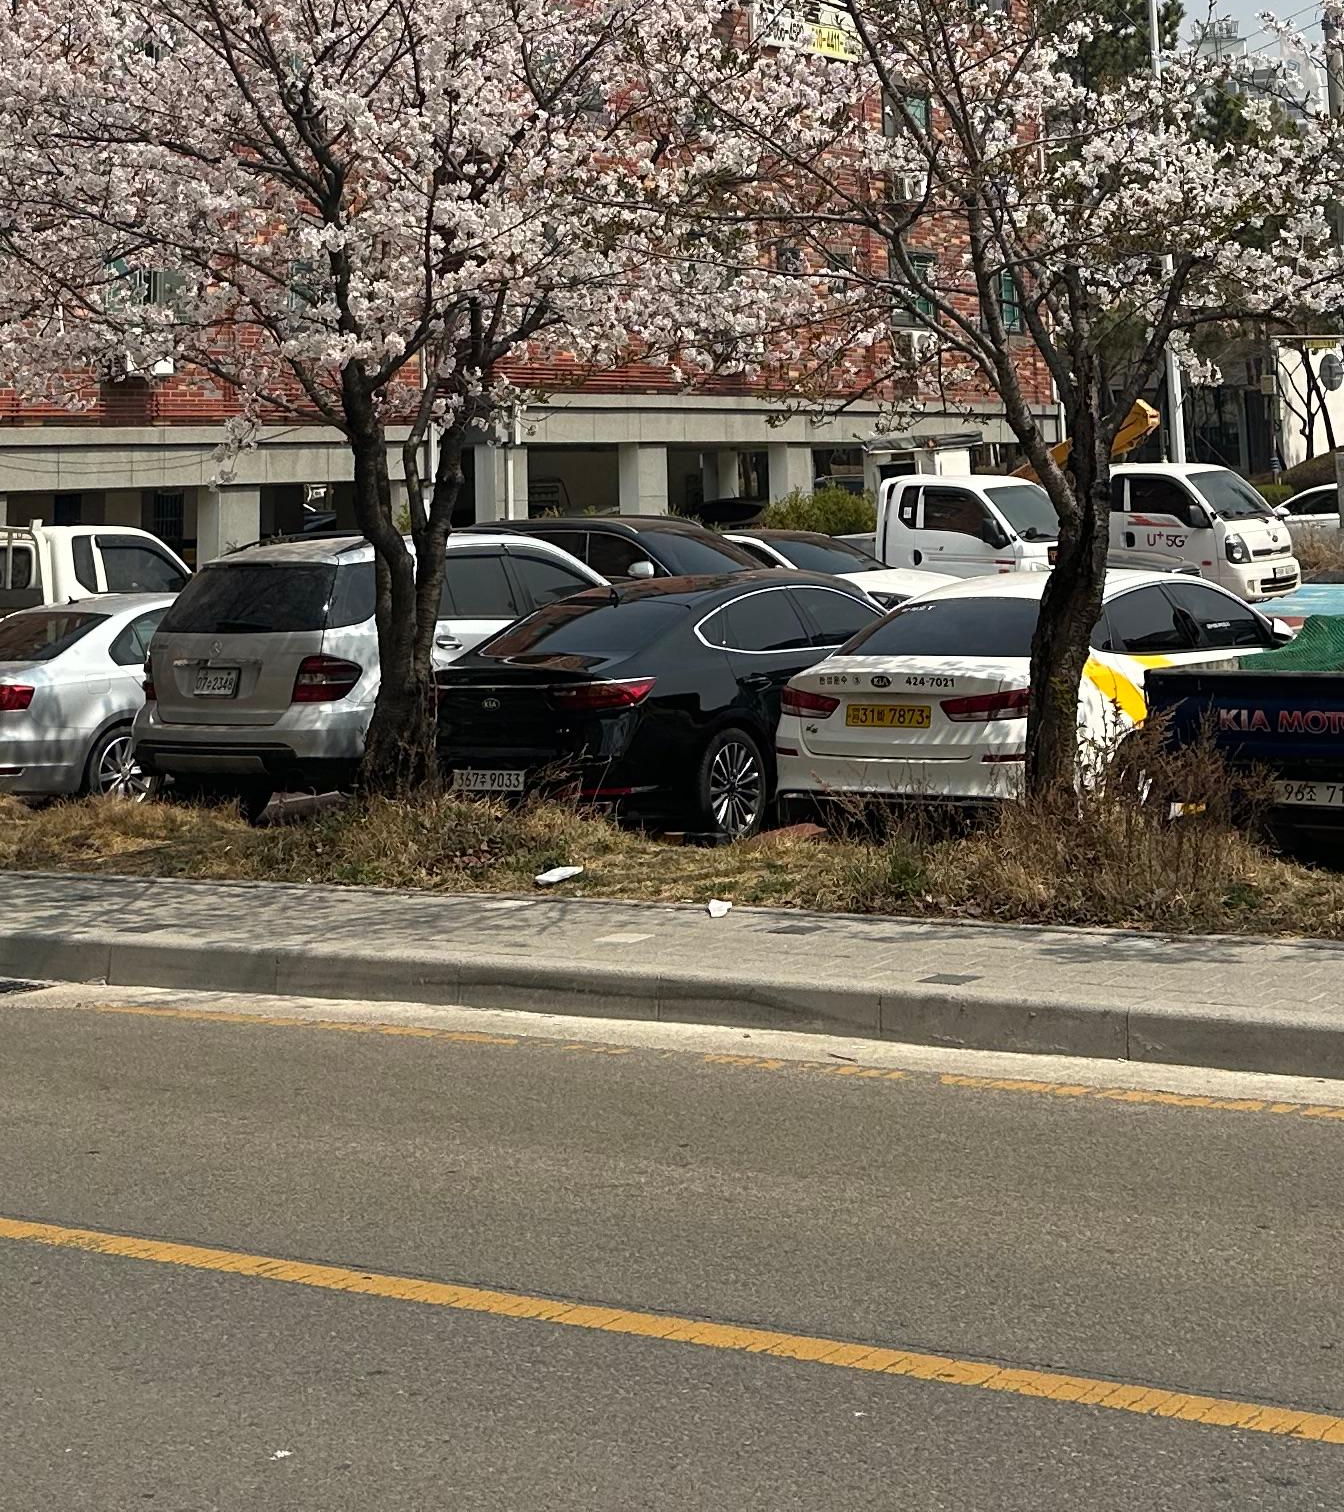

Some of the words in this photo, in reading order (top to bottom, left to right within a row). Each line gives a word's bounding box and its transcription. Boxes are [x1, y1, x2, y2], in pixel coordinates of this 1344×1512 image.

[906, 677, 955, 688] 424-7021
[889, 708, 925, 725] 7873
[1219, 709, 1271, 732] KIA
[490, 772, 520, 788] 9033
